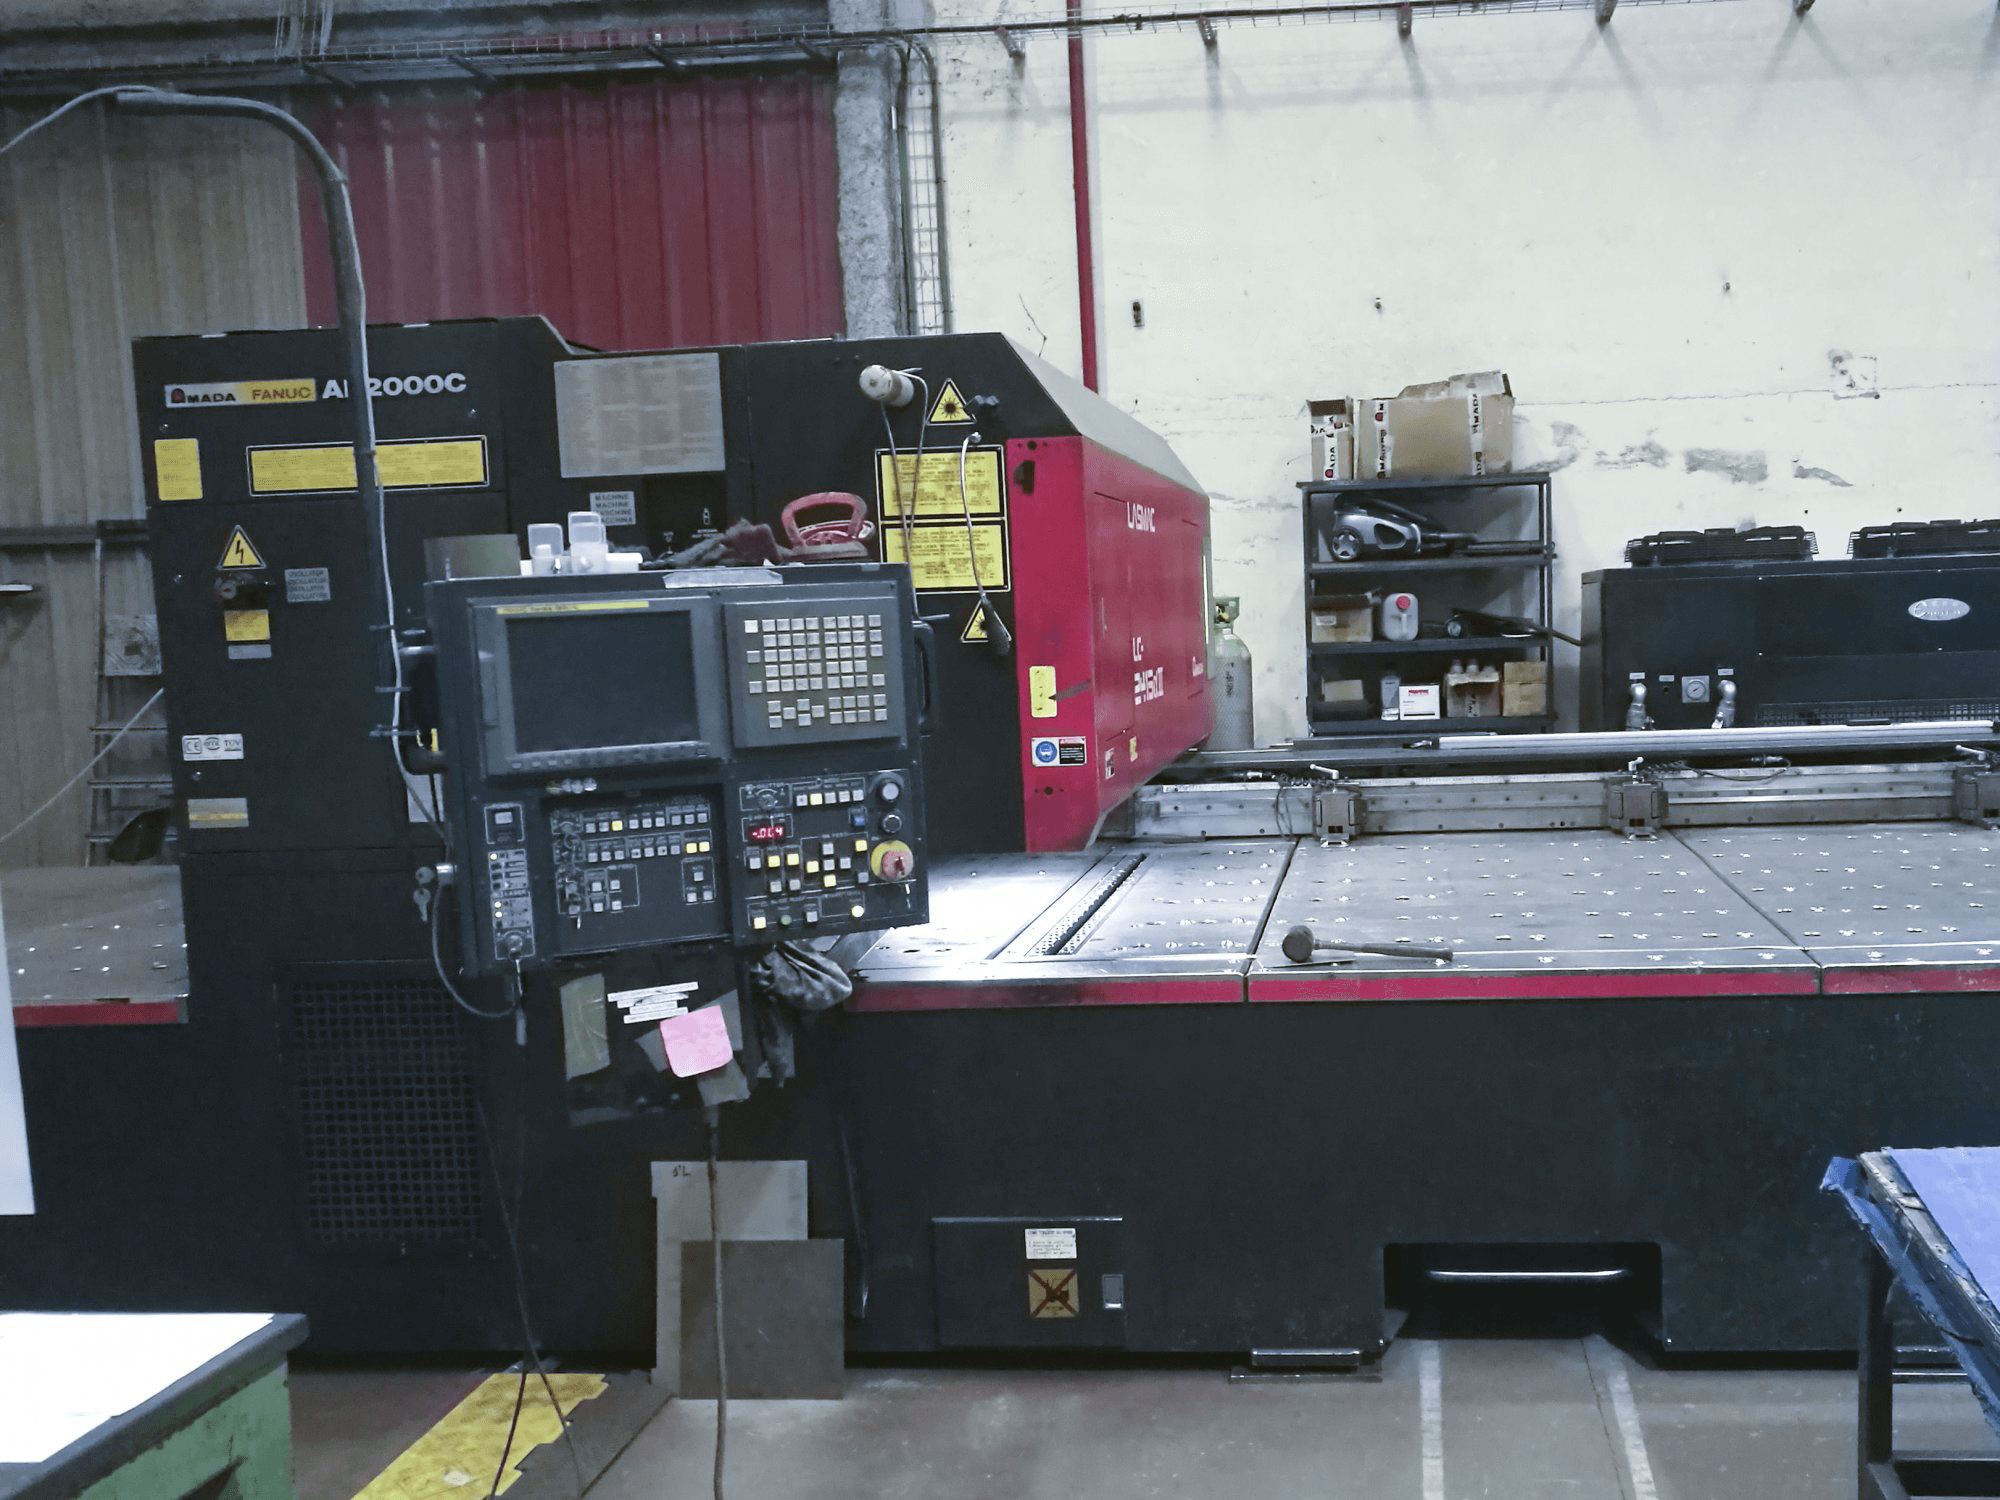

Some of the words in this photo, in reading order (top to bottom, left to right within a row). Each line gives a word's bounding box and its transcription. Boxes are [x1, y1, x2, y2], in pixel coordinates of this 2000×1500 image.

[322, 373, 467, 399] A2000C
[252, 387, 312, 401] FANUC
[595, 493, 629, 501] MACHINE
